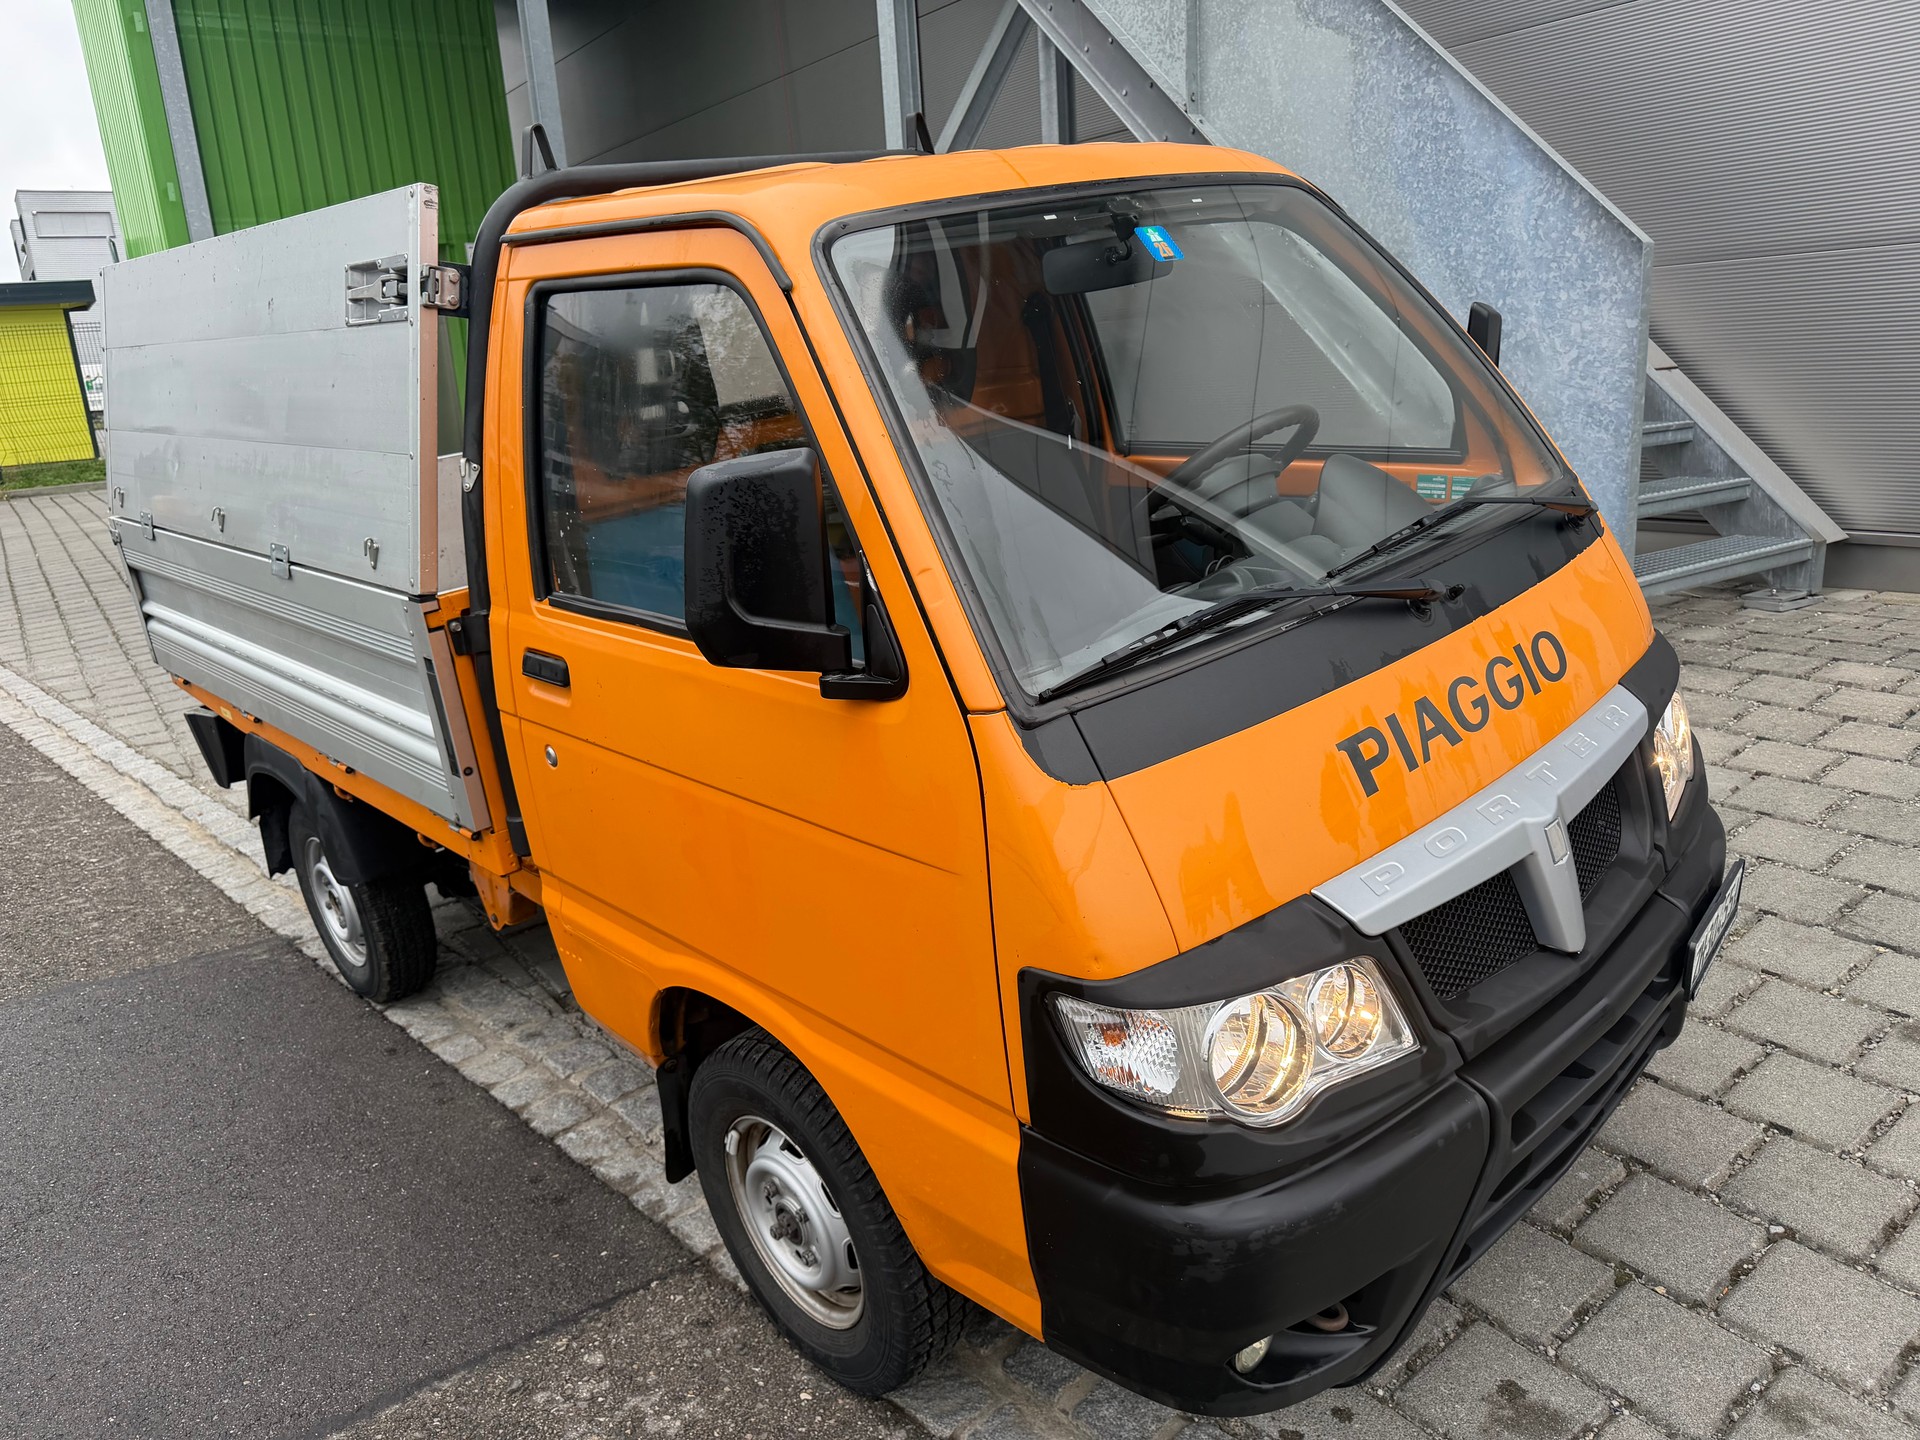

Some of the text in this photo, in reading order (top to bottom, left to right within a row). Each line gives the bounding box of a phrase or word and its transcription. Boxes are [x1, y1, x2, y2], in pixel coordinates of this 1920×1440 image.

[1154, 241, 1174, 258] 26
[1335, 630, 1568, 798] PIAGGIO
[1360, 704, 1629, 896] PORTER
